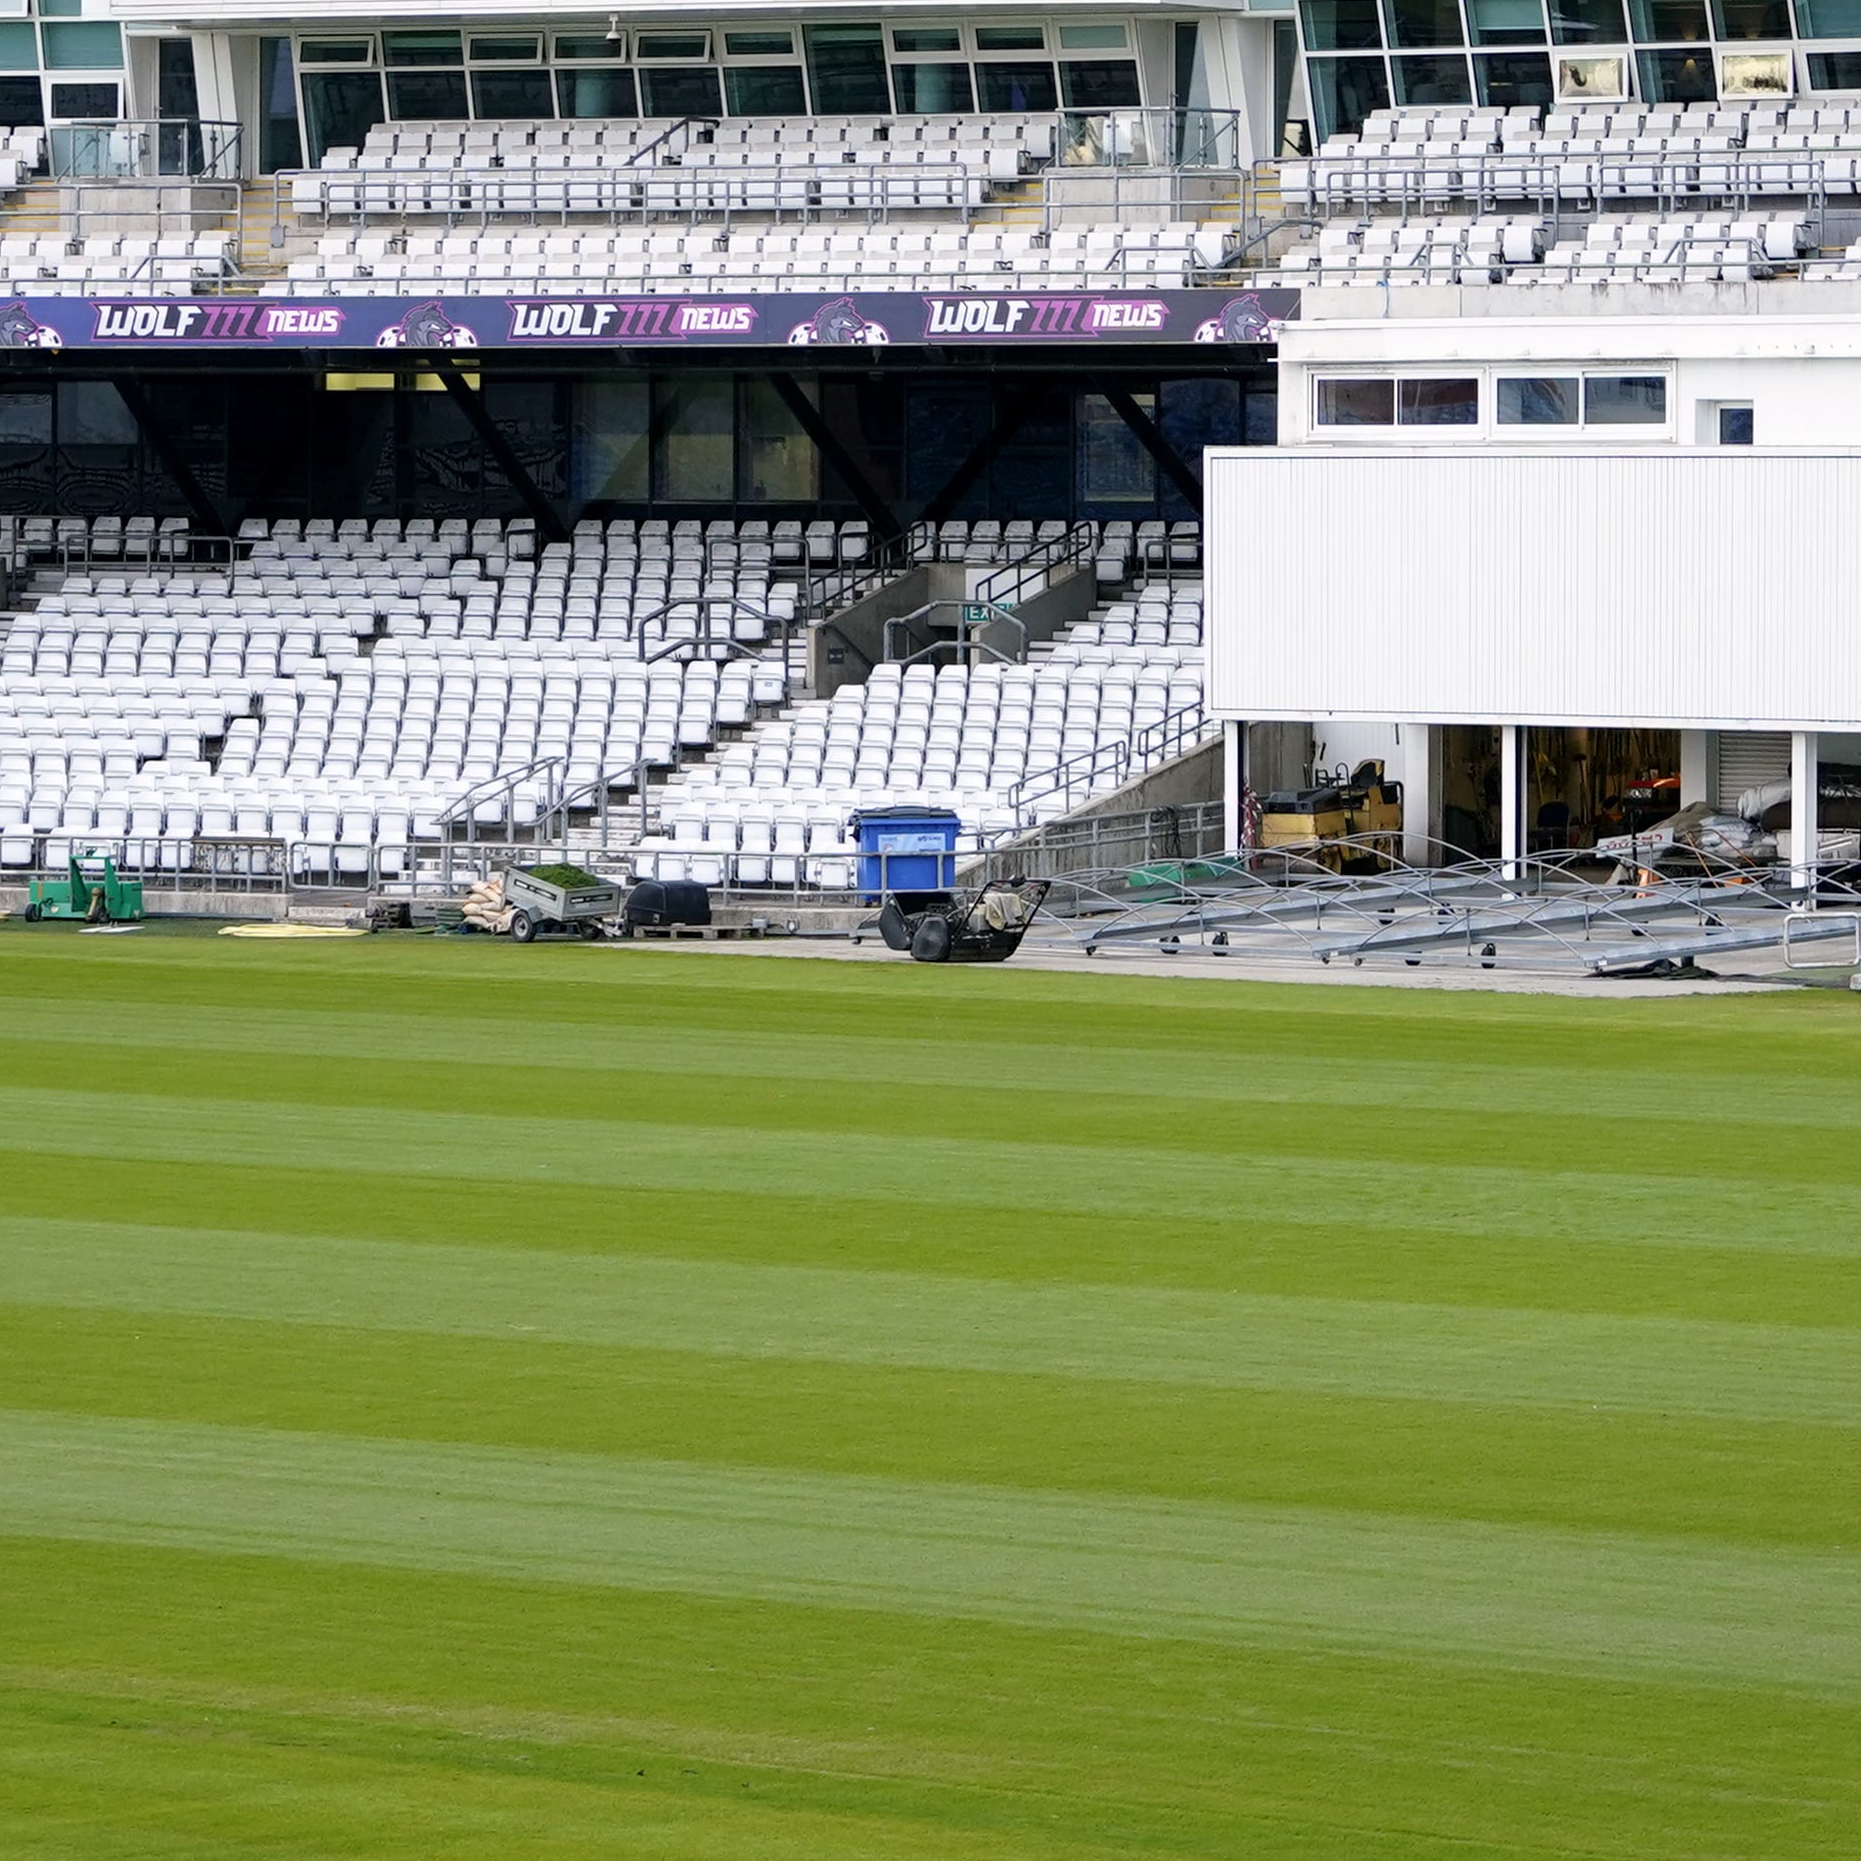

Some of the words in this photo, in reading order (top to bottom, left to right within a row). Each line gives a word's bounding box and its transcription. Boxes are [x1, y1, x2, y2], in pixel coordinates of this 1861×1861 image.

[267, 310, 341, 332] NEWS
[680, 307, 752, 331] NEWS
[1092, 303, 1164, 327] NEWS
